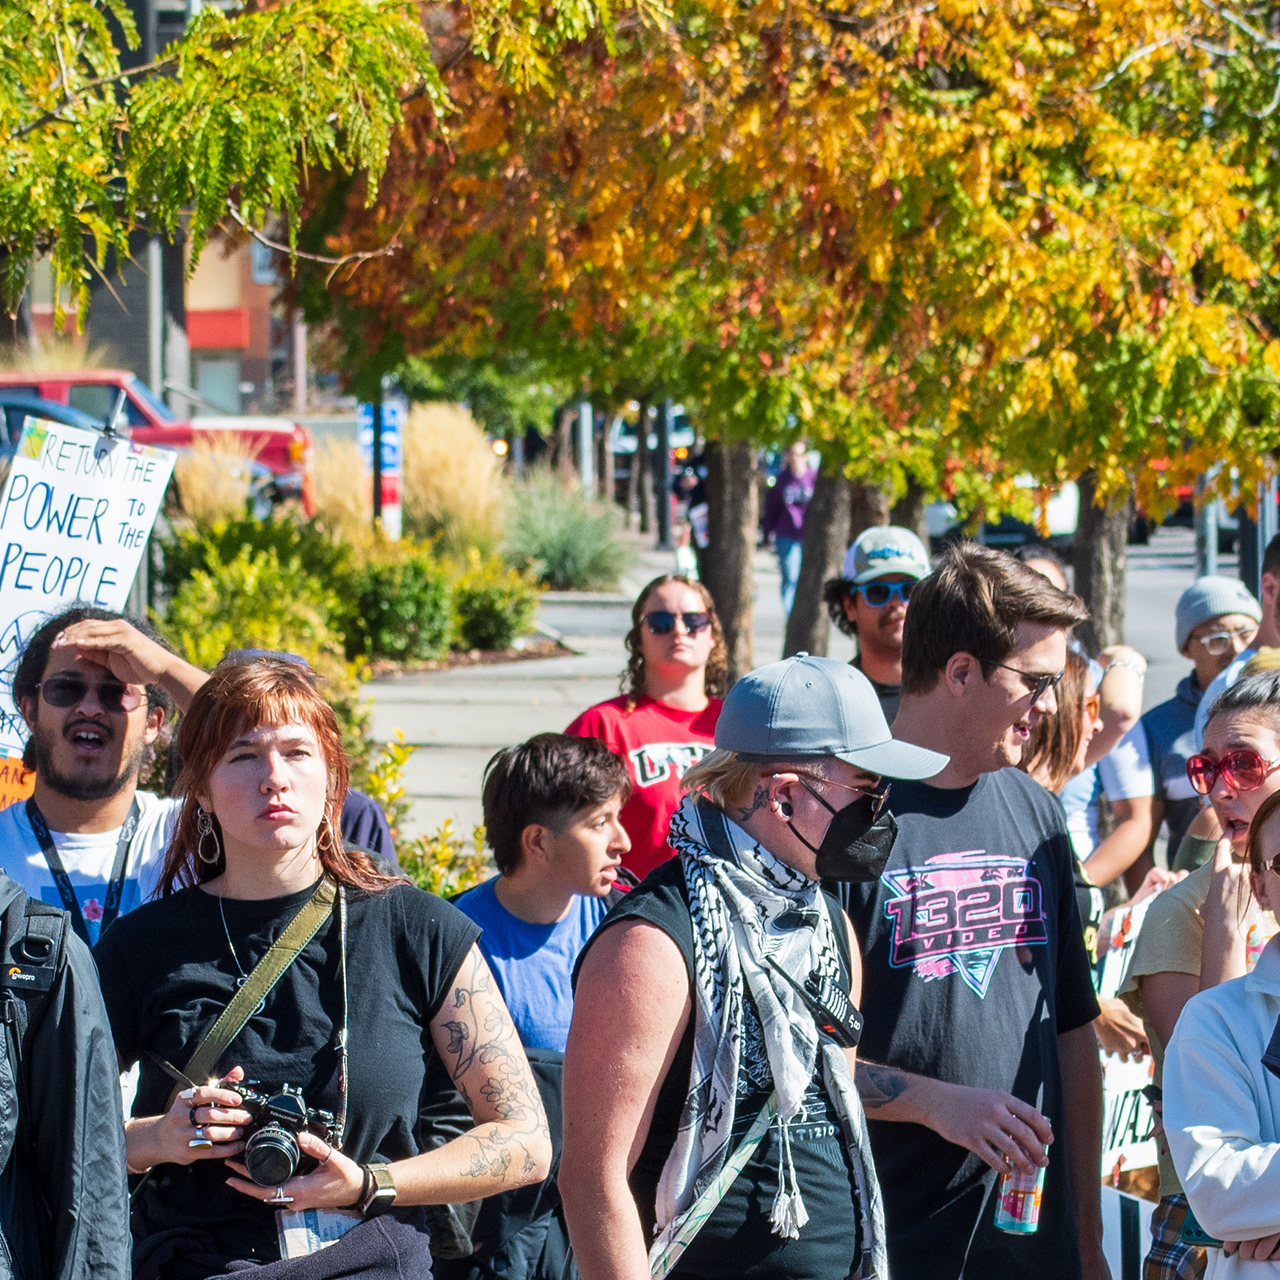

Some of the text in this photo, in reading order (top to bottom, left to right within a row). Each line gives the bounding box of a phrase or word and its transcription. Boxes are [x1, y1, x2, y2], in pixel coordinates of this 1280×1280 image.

[42, 434, 156, 484] RETURN THE
[0, 475, 146, 545] POWER TO
[118, 521, 145, 549] THE
[886, 877, 1043, 945] 1320
[922, 924, 1028, 949] VIDEO
